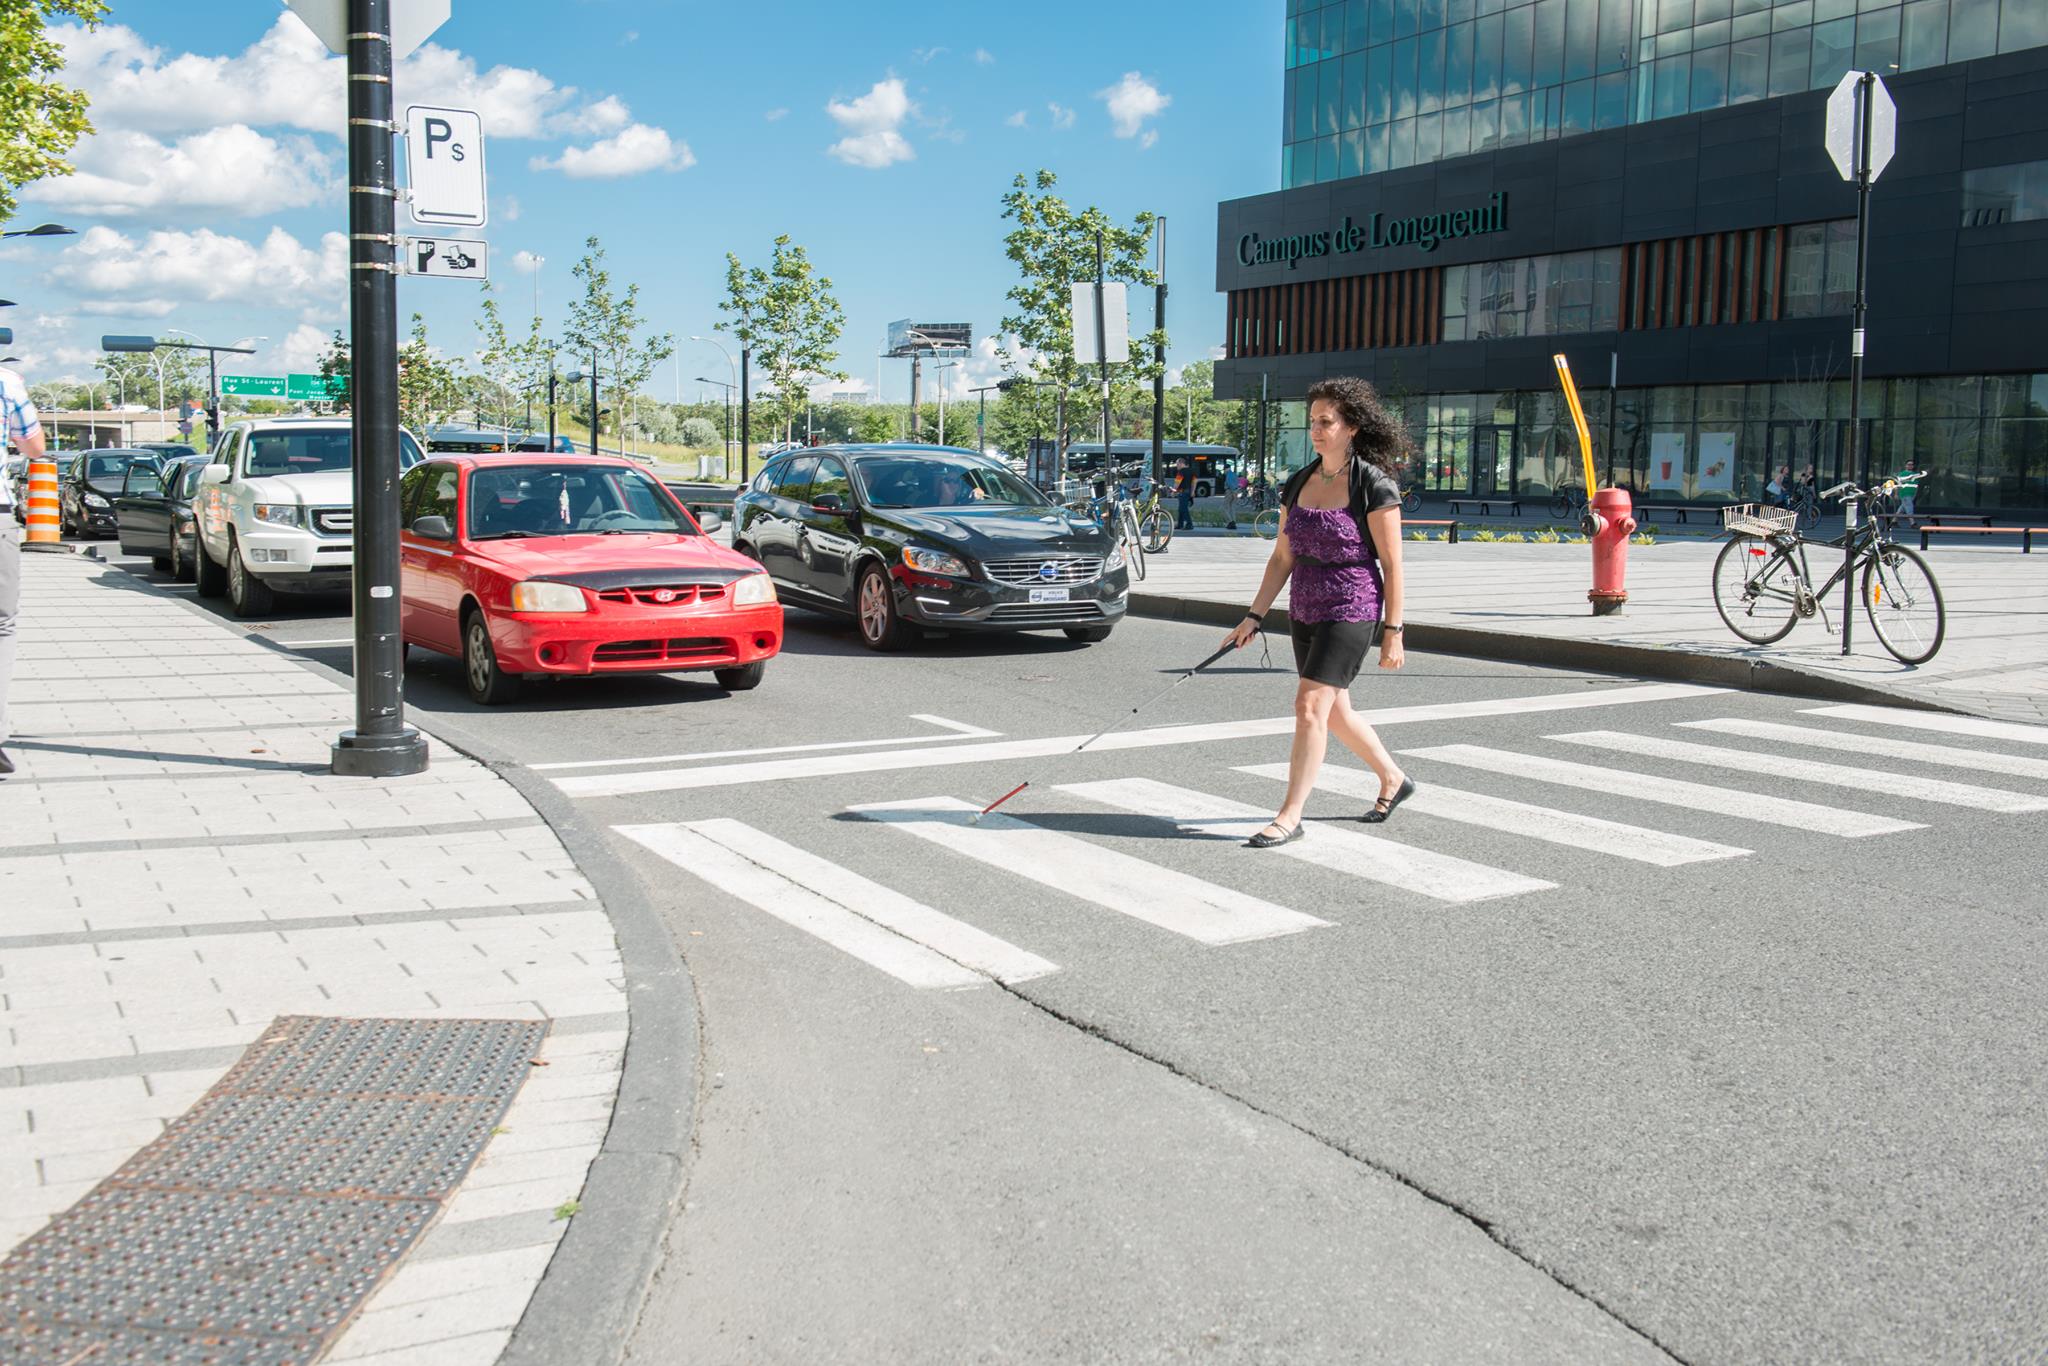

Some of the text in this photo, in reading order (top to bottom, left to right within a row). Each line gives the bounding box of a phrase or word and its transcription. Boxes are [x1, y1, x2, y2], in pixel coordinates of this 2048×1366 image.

[1237, 192, 1508, 270] Campus de Longueuil
